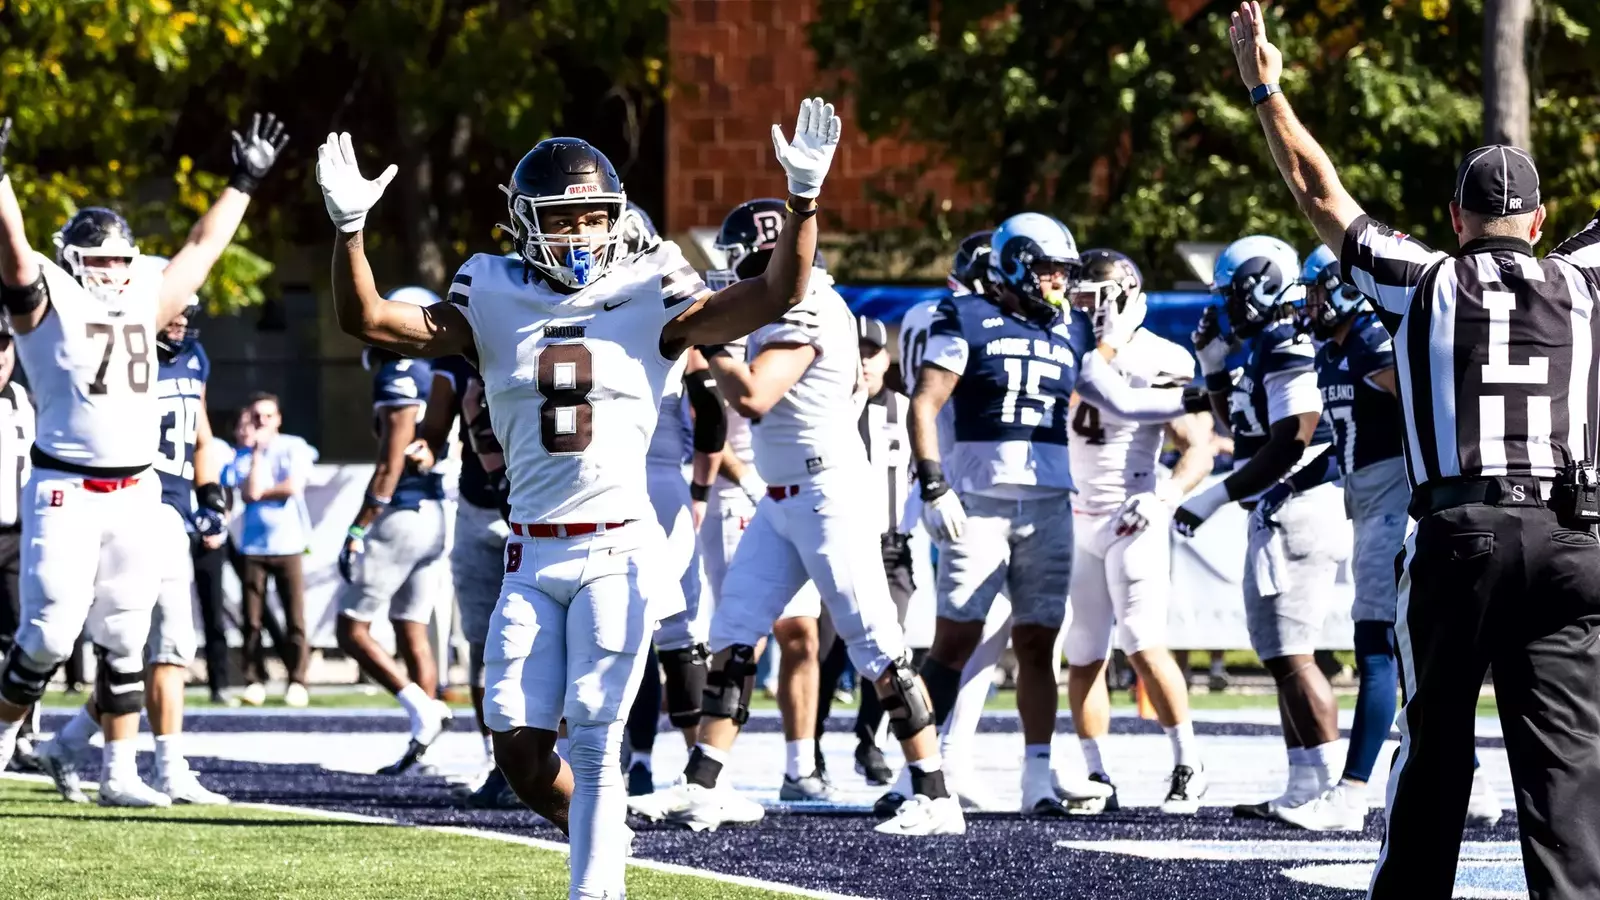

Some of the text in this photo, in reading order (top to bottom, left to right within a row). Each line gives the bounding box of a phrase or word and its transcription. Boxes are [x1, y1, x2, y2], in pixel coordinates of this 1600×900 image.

[568, 184, 598, 195] BEARS
[1509, 198, 1522, 210] RR
[753, 210, 783, 250] B
[543, 325, 587, 339] BROWN
[1481, 291, 1549, 384] L
[85, 322, 150, 395] 78
[534, 342, 595, 456] 8
[1001, 357, 1062, 428] 15
[1072, 401, 1105, 445] 4
[50, 489, 64, 507] B
[1512, 484, 1526, 502] S
